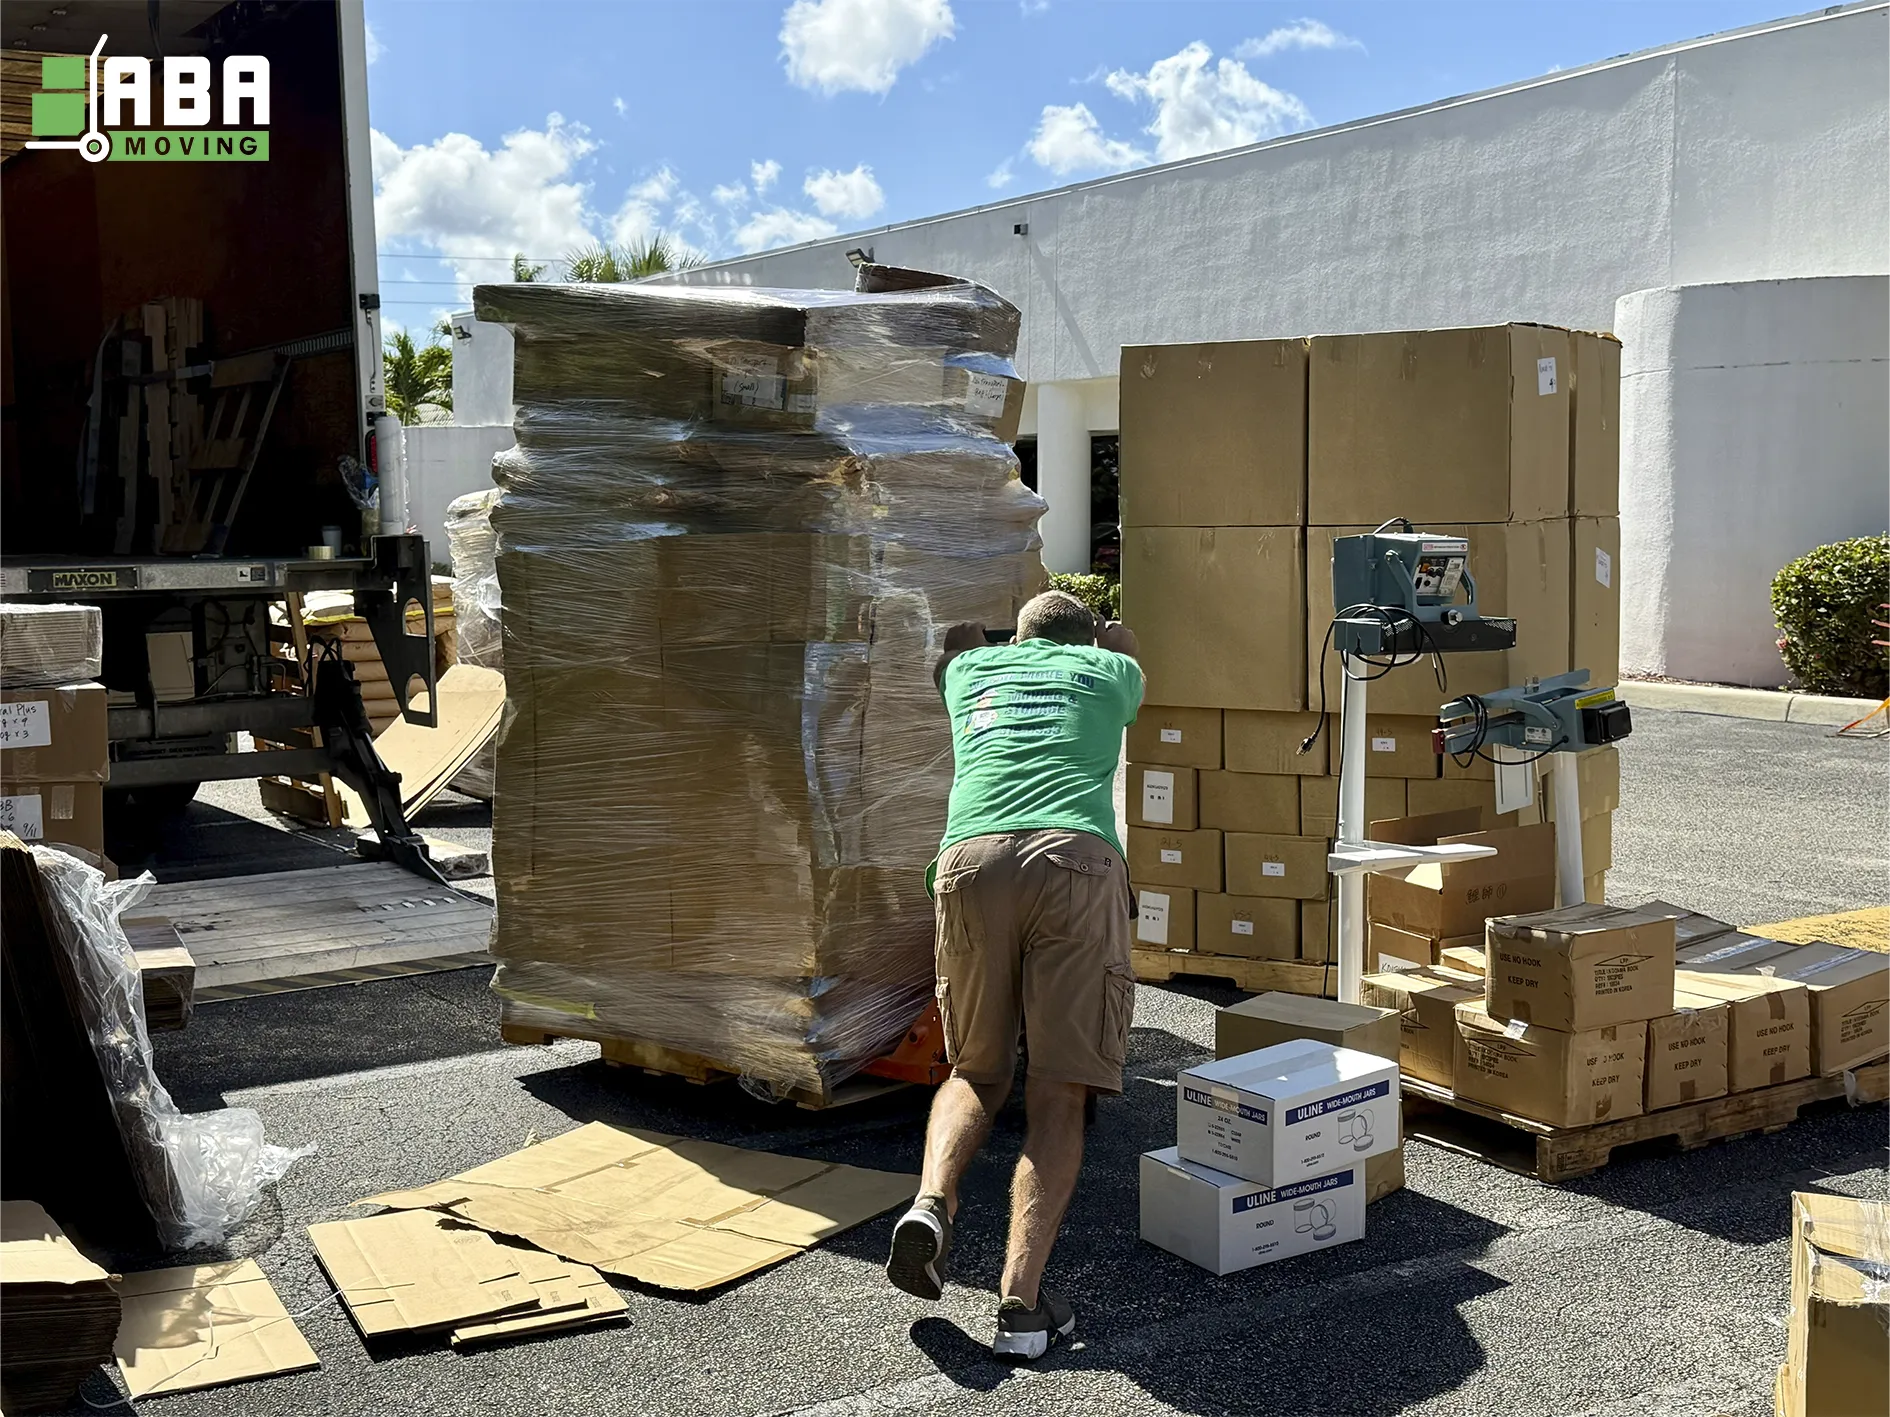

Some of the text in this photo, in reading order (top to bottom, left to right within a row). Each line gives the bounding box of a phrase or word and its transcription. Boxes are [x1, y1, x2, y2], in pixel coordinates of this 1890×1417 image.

[55, 573, 112, 587] MAXON
[16, 703, 37, 716] Plus
[23, 730, 29, 739] 3
[8, 812, 15, 822] 6
[23, 822, 37, 838] 9/11
[1499, 953, 1542, 967] USE NO HOOK
[1507, 975, 1539, 988] KEEP DRY
[1757, 1022, 1795, 1038] USE NO HOOK
[1668, 1036, 1706, 1051] USE NO HOOK
[1763, 1044, 1791, 1057] KEEP DRY
[1674, 1058, 1702, 1071] KEEP DRY
[1591, 1074, 1620, 1087] KEEP DRY
[1186, 1089, 1266, 1122] ULINE WIDE-MOUTH JARS
[1297, 1087, 1377, 1120] ULINE WIDE-MOUTH JARS
[1305, 1131, 1321, 1141] ROUND
[1246, 1177, 1338, 1208] ULINE WIDE-MOUTH JARS
[1256, 1219, 1274, 1230] ROUND
